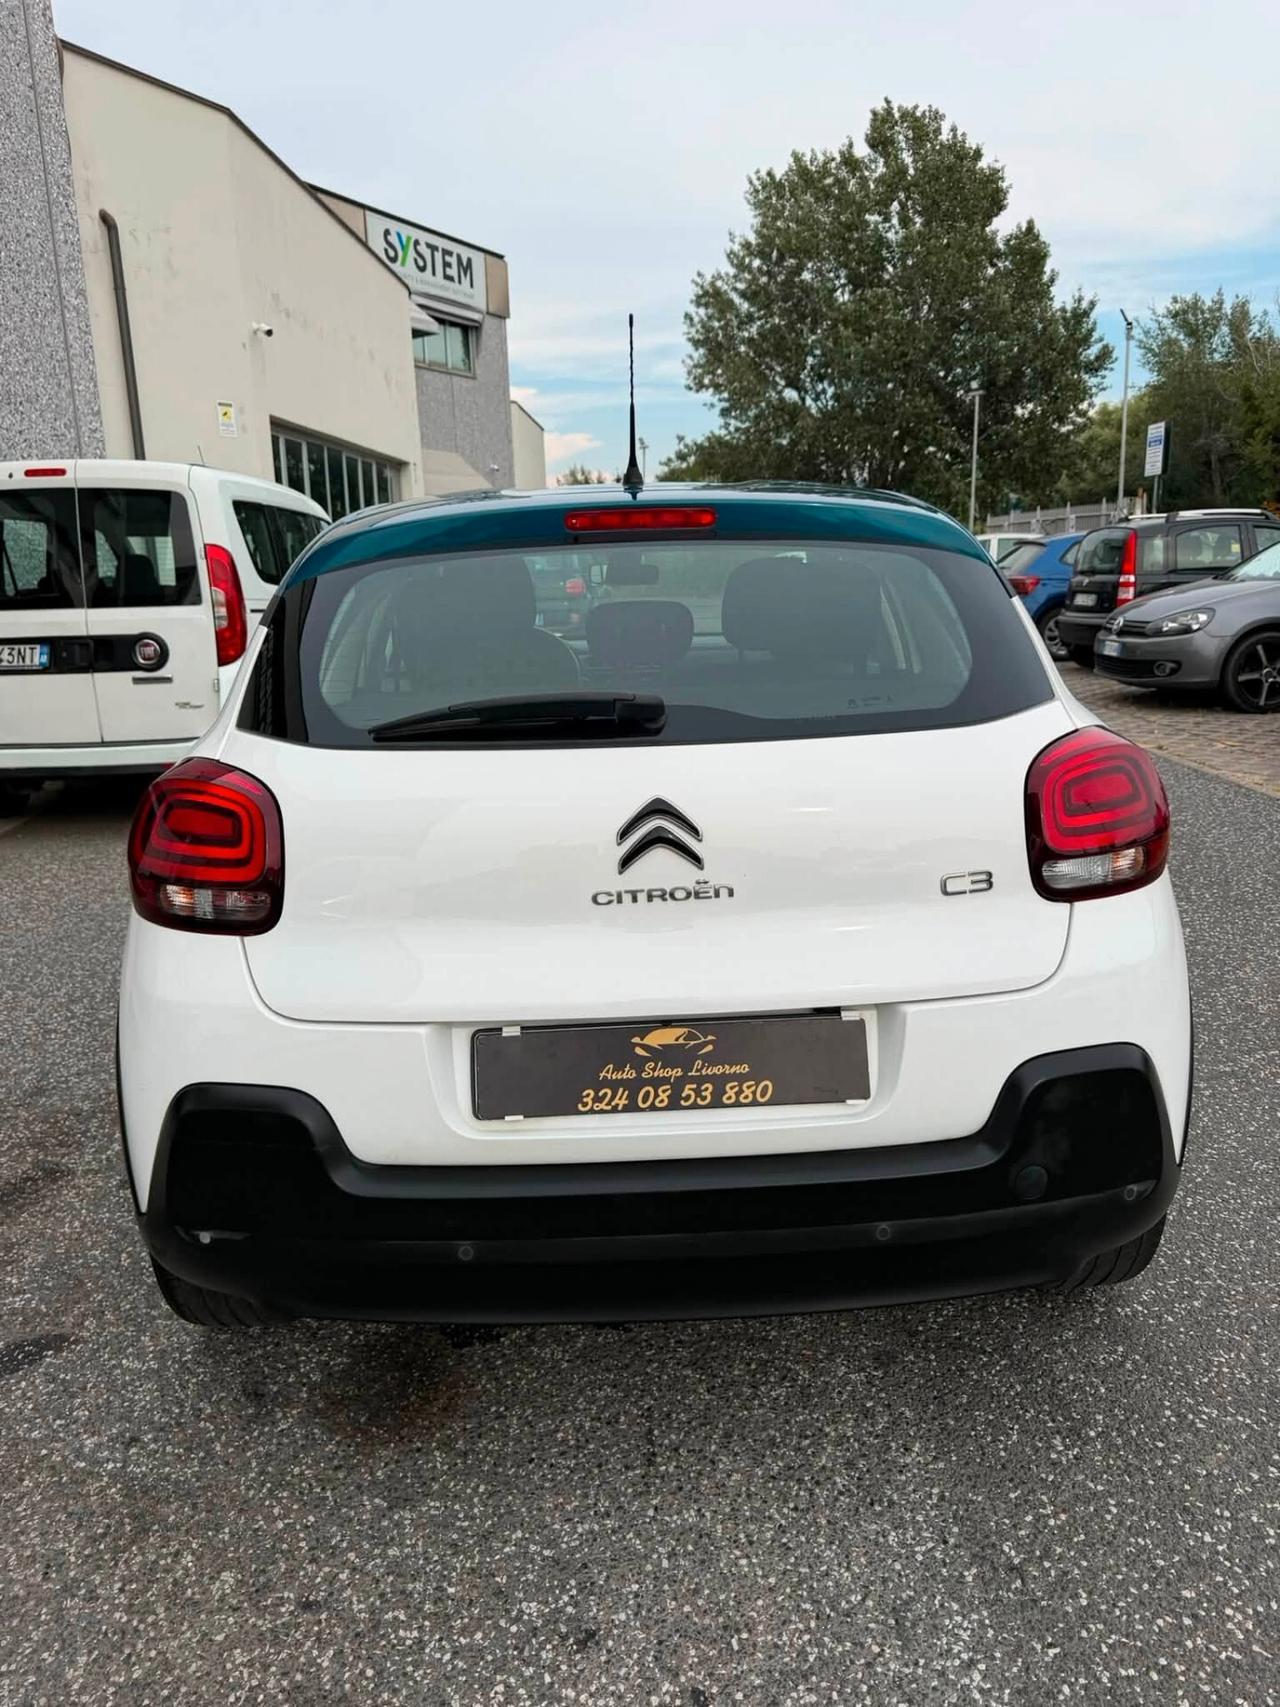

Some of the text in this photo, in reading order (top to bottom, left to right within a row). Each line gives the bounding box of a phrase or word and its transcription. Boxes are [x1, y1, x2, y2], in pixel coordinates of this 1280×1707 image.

[383, 228, 474, 289] SYSTEM
[940, 870, 993, 896] C3
[600, 1059, 750, 1083] Auto Shop Livorno
[577, 1079, 774, 1112] 324 08 53 880
